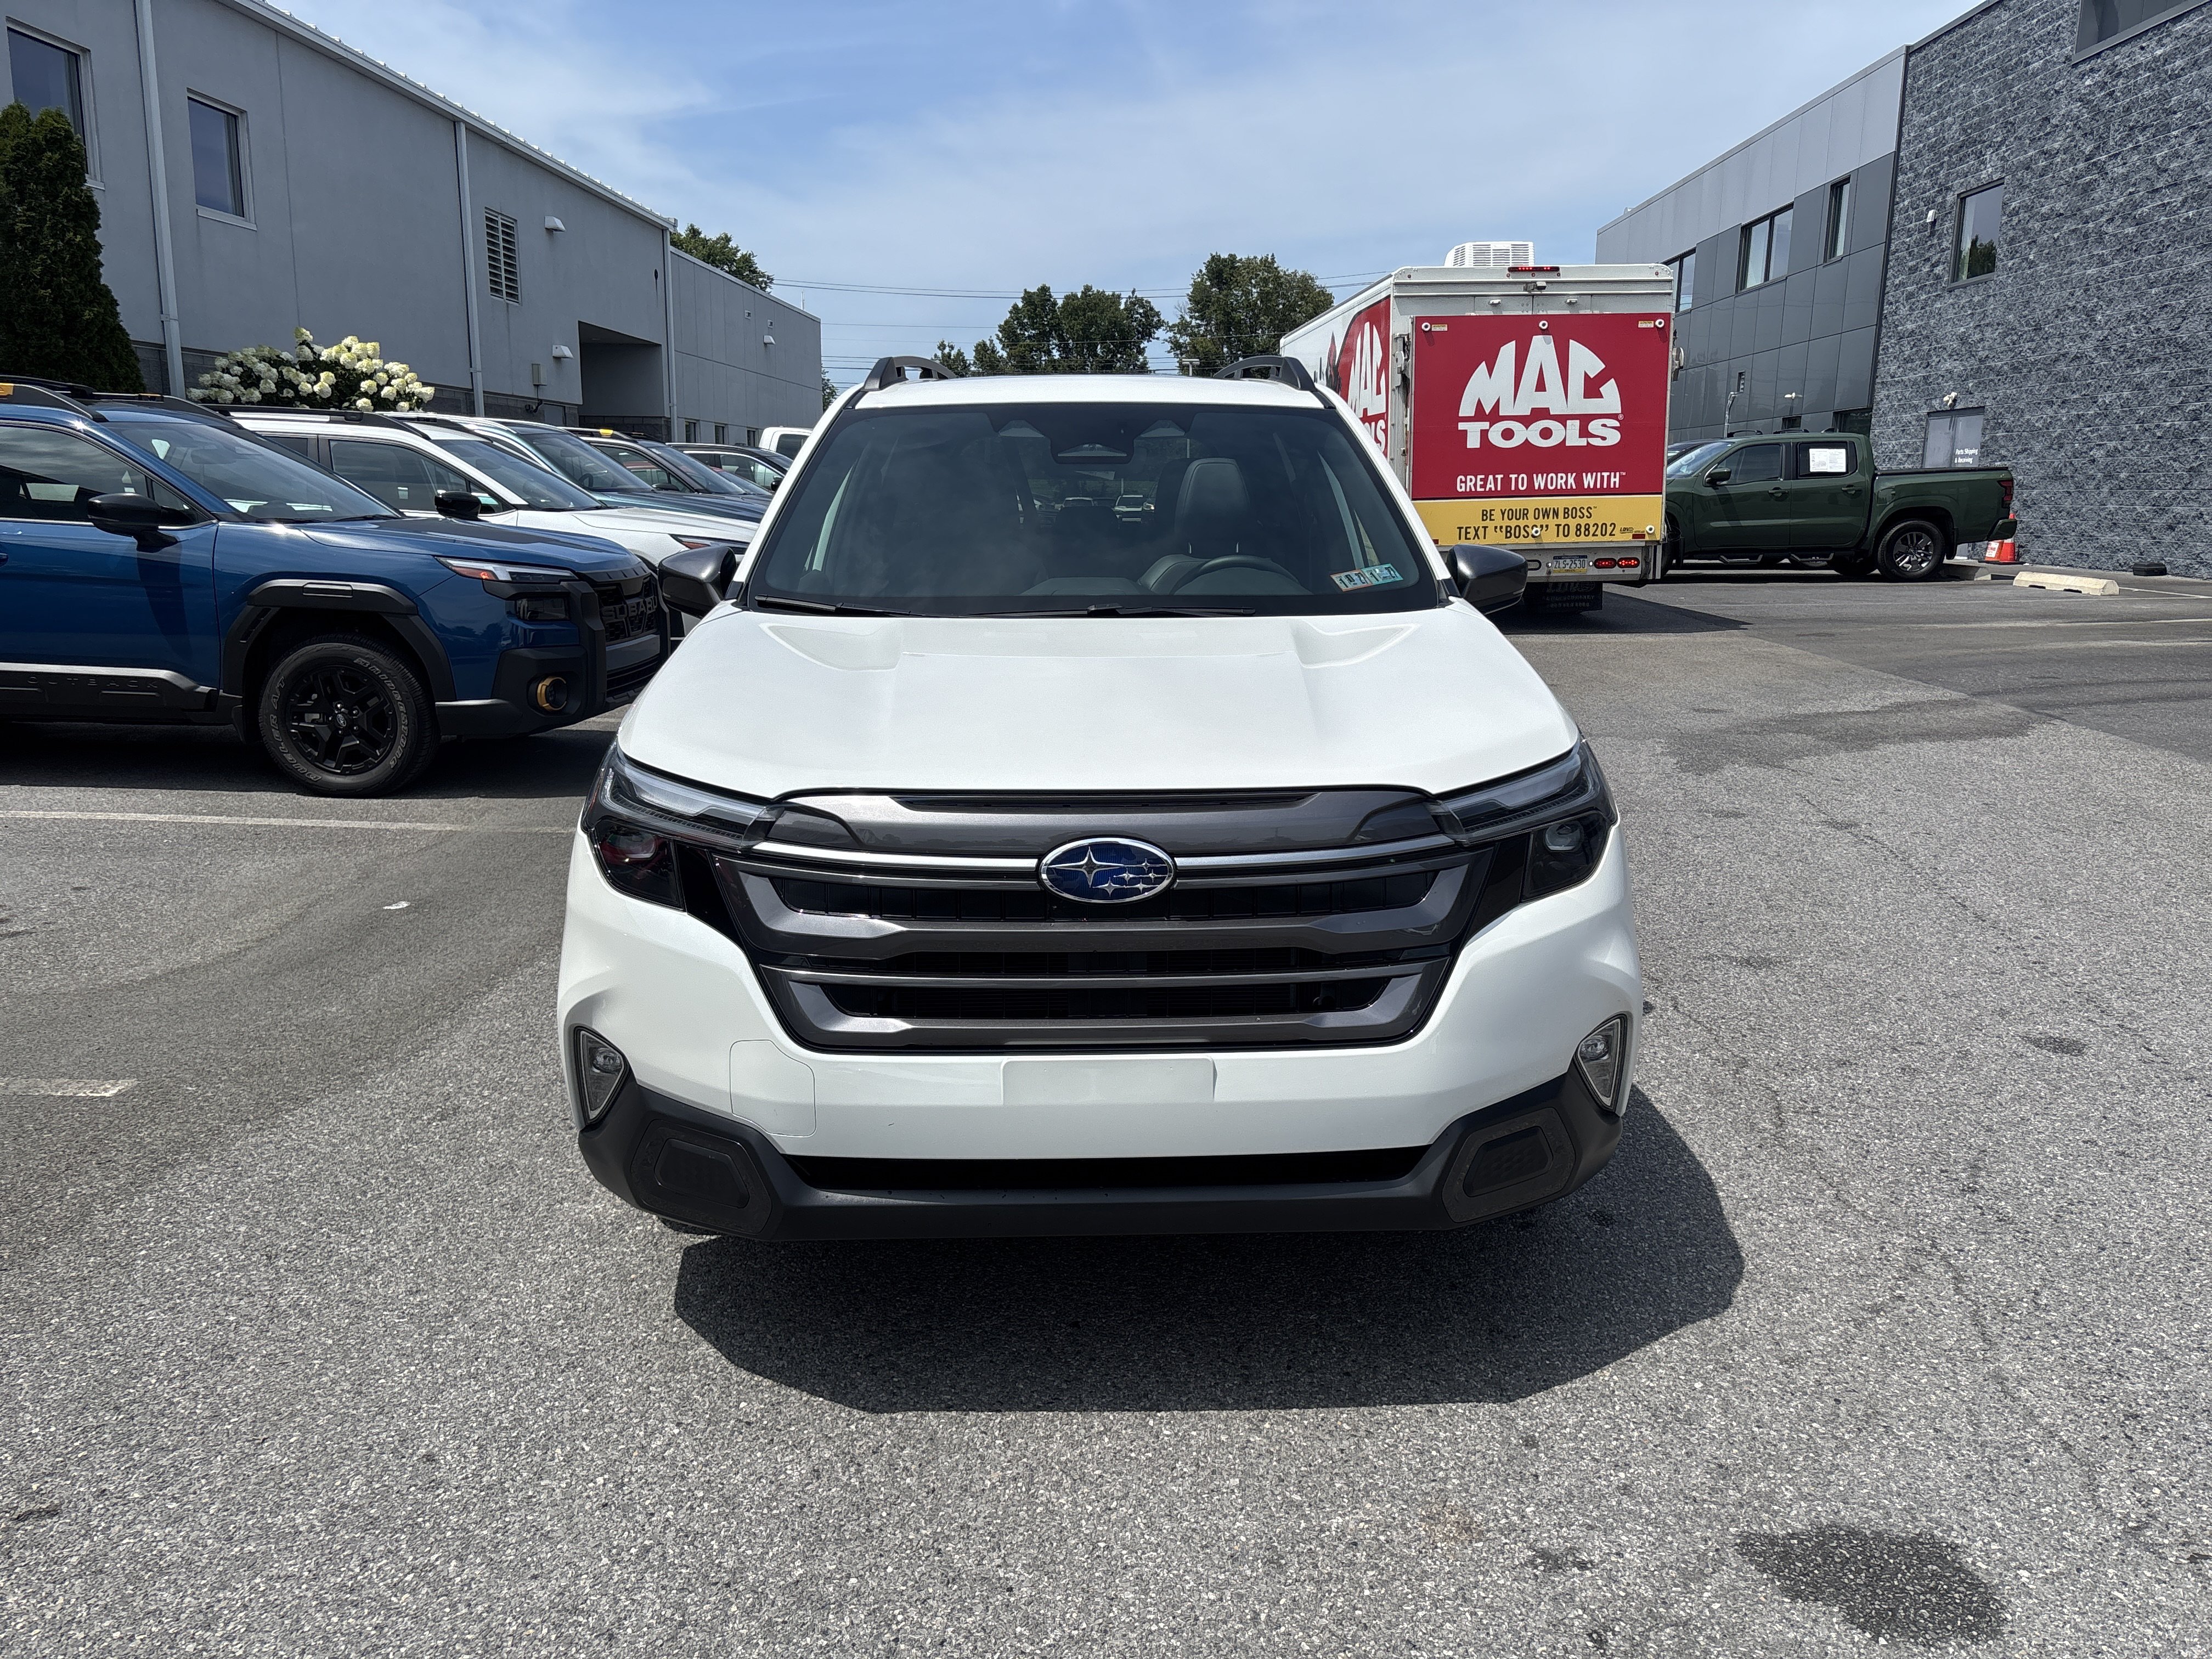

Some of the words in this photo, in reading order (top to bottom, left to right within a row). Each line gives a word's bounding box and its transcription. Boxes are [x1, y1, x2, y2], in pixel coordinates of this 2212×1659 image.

[1458, 335, 1622, 417] MAC
[1458, 419, 1621, 449] TOOLS
[1457, 475, 1504, 492] GREAT
[1509, 474, 1527, 490] TO
[1533, 472, 1577, 490] WORK
[1481, 509, 1496, 521] BE
[1500, 508, 1529, 521] YOUR
[1533, 507, 1559, 520] OWN
[1457, 526, 1488, 540] TEXT
[1555, 523, 1570, 537] TO
[1575, 523, 1616, 537] 88202
[601, 596, 658, 622] SUBARU
[27, 676, 158, 689] OUTBACK
[353, 658, 408, 769] BRIDGESTONE
